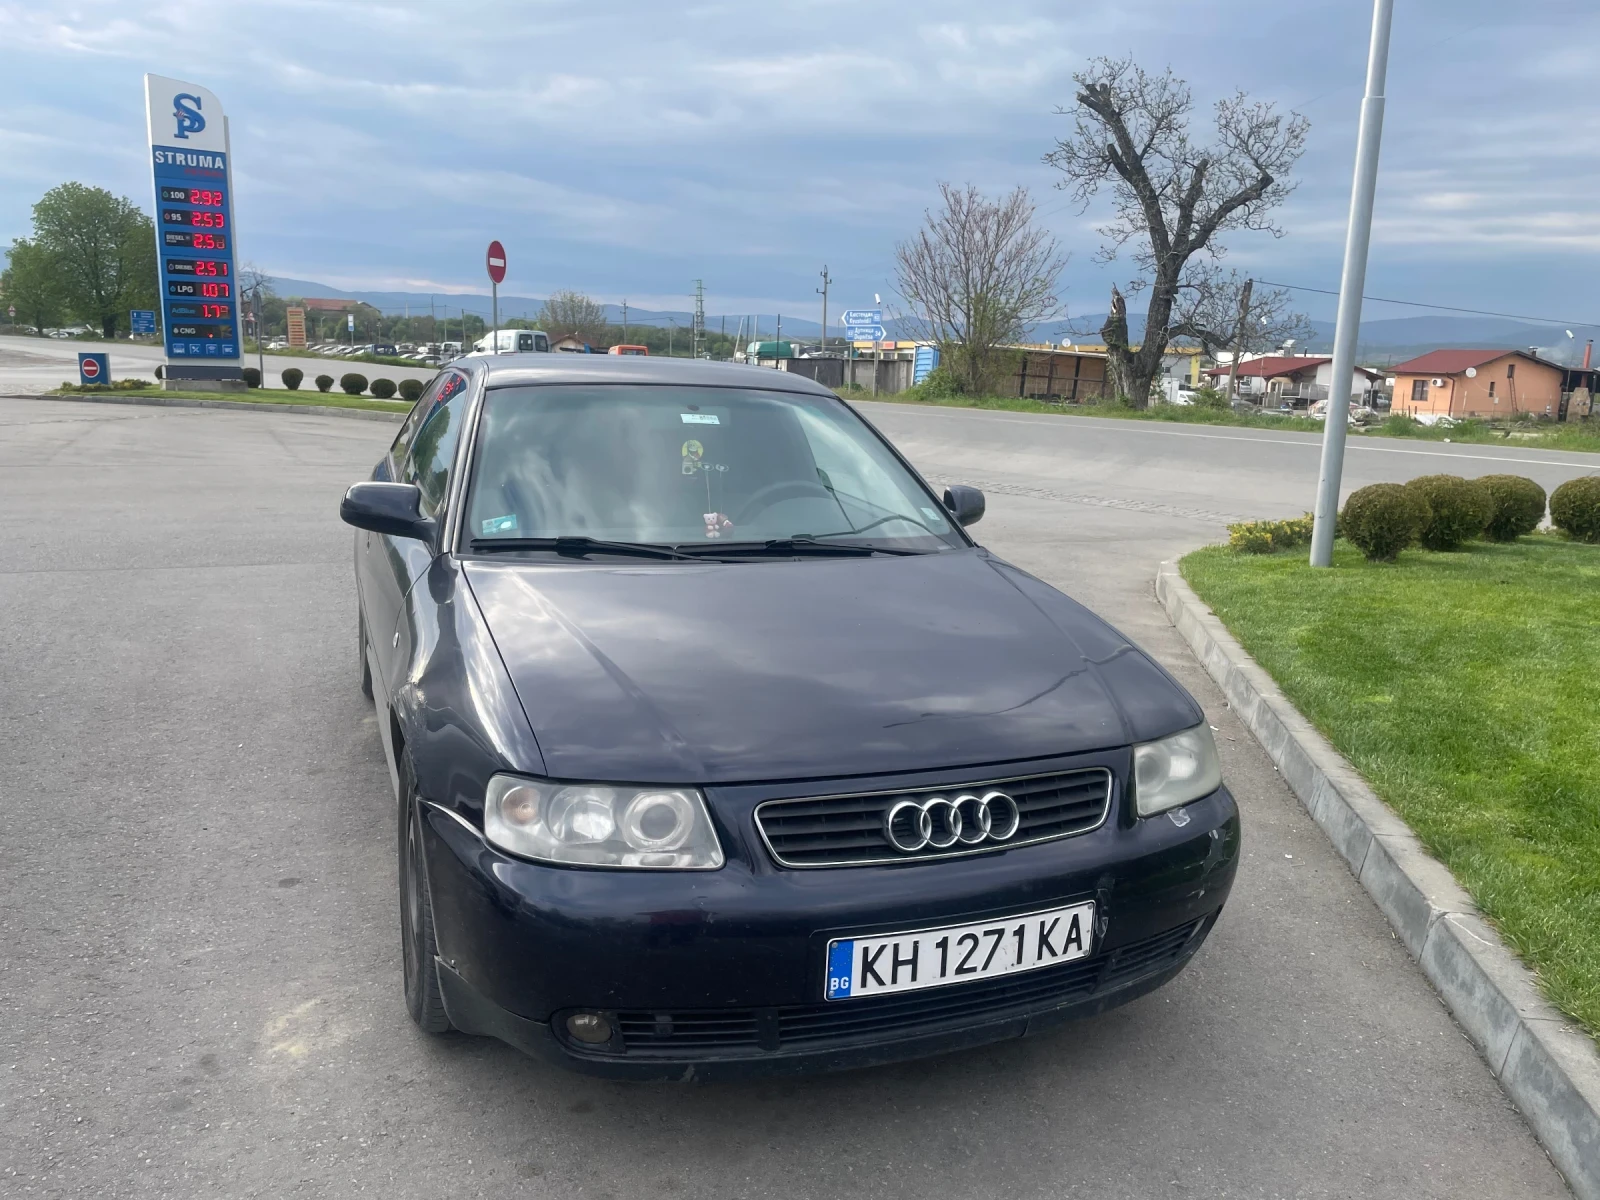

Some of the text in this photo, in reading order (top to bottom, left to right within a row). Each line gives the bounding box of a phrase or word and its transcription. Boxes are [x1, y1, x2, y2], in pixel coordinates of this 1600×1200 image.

[155, 150, 224, 169] STRUMA
[170, 189, 222, 206] 100 2.92
[171, 211, 224, 228] 95 2.53
[195, 261, 227, 276] 2.51
[177, 283, 229, 297] LPG 1.07
[935, 924, 1026, 978] 1271
[830, 976, 849, 990] BG
